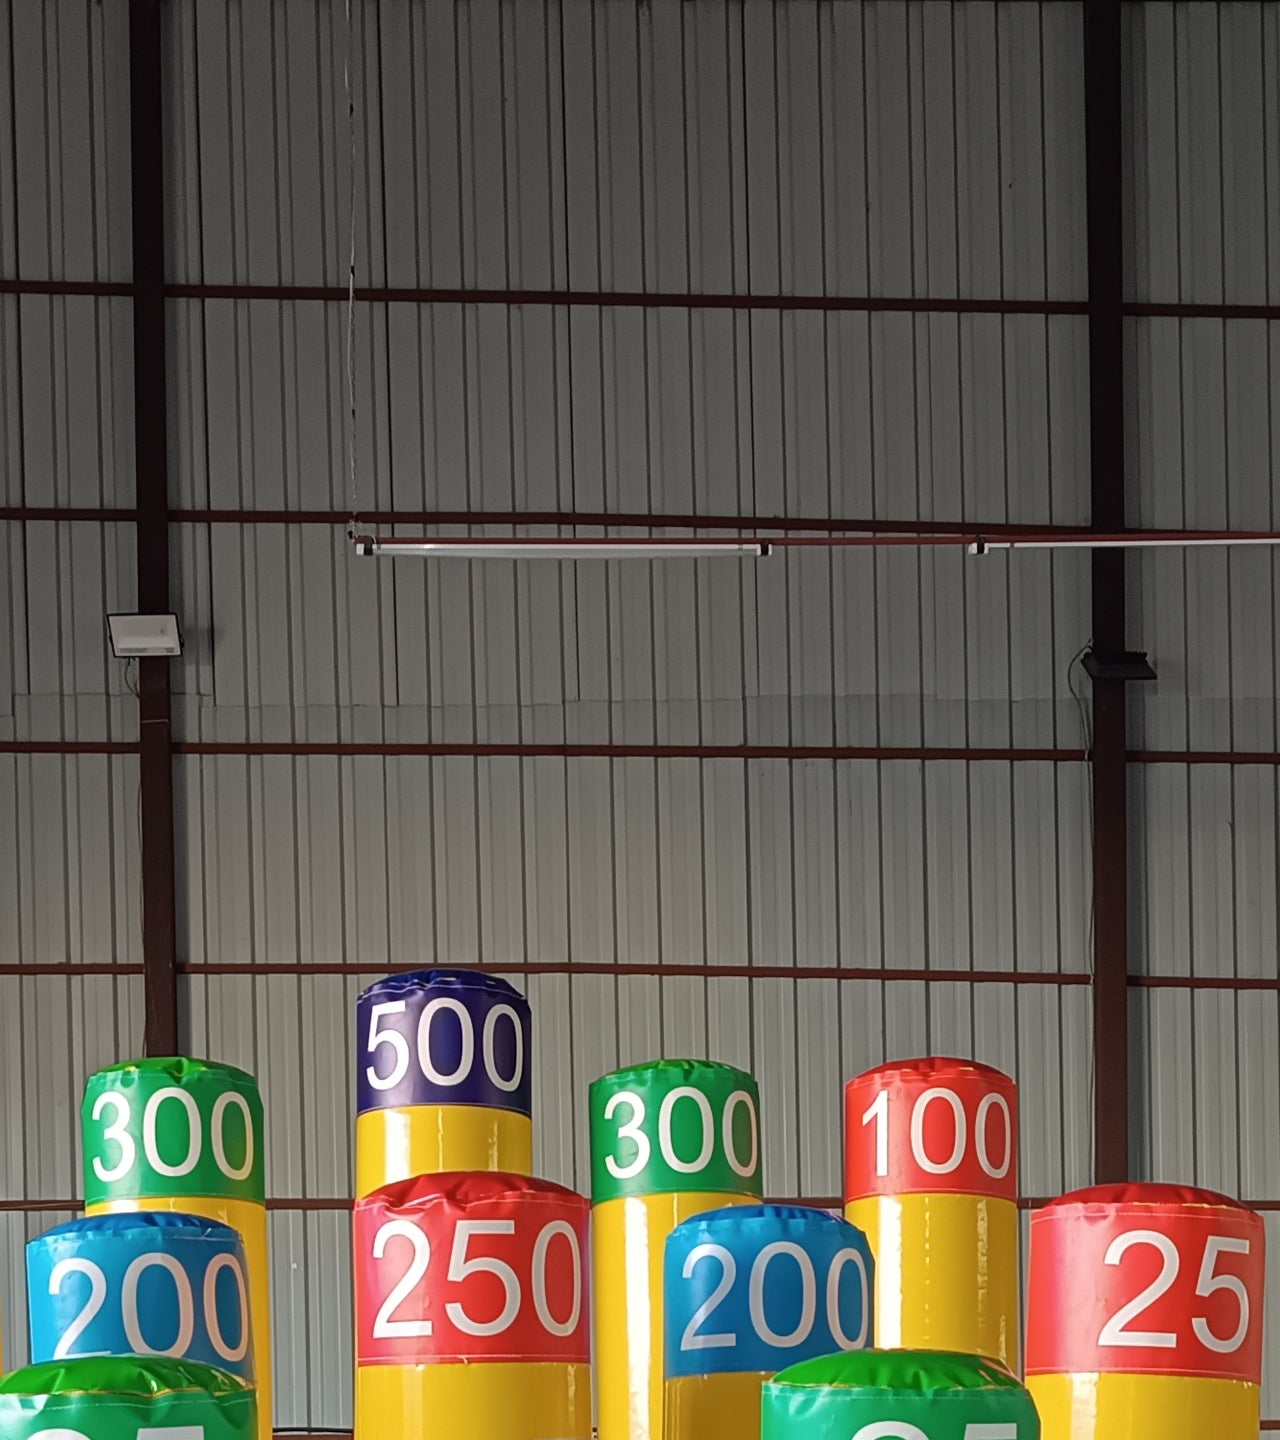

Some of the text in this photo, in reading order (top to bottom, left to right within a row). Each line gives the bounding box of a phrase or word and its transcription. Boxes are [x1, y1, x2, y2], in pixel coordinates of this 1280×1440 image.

[366, 1000, 524, 1091] 500
[90, 1088, 254, 1182] 300
[604, 1087, 758, 1179] 300
[862, 1088, 1012, 1178] 100
[48, 1253, 248, 1360] 200
[372, 1220, 581, 1339] 250
[681, 1242, 868, 1351] 200
[1098, 1231, 1250, 1352] 25
